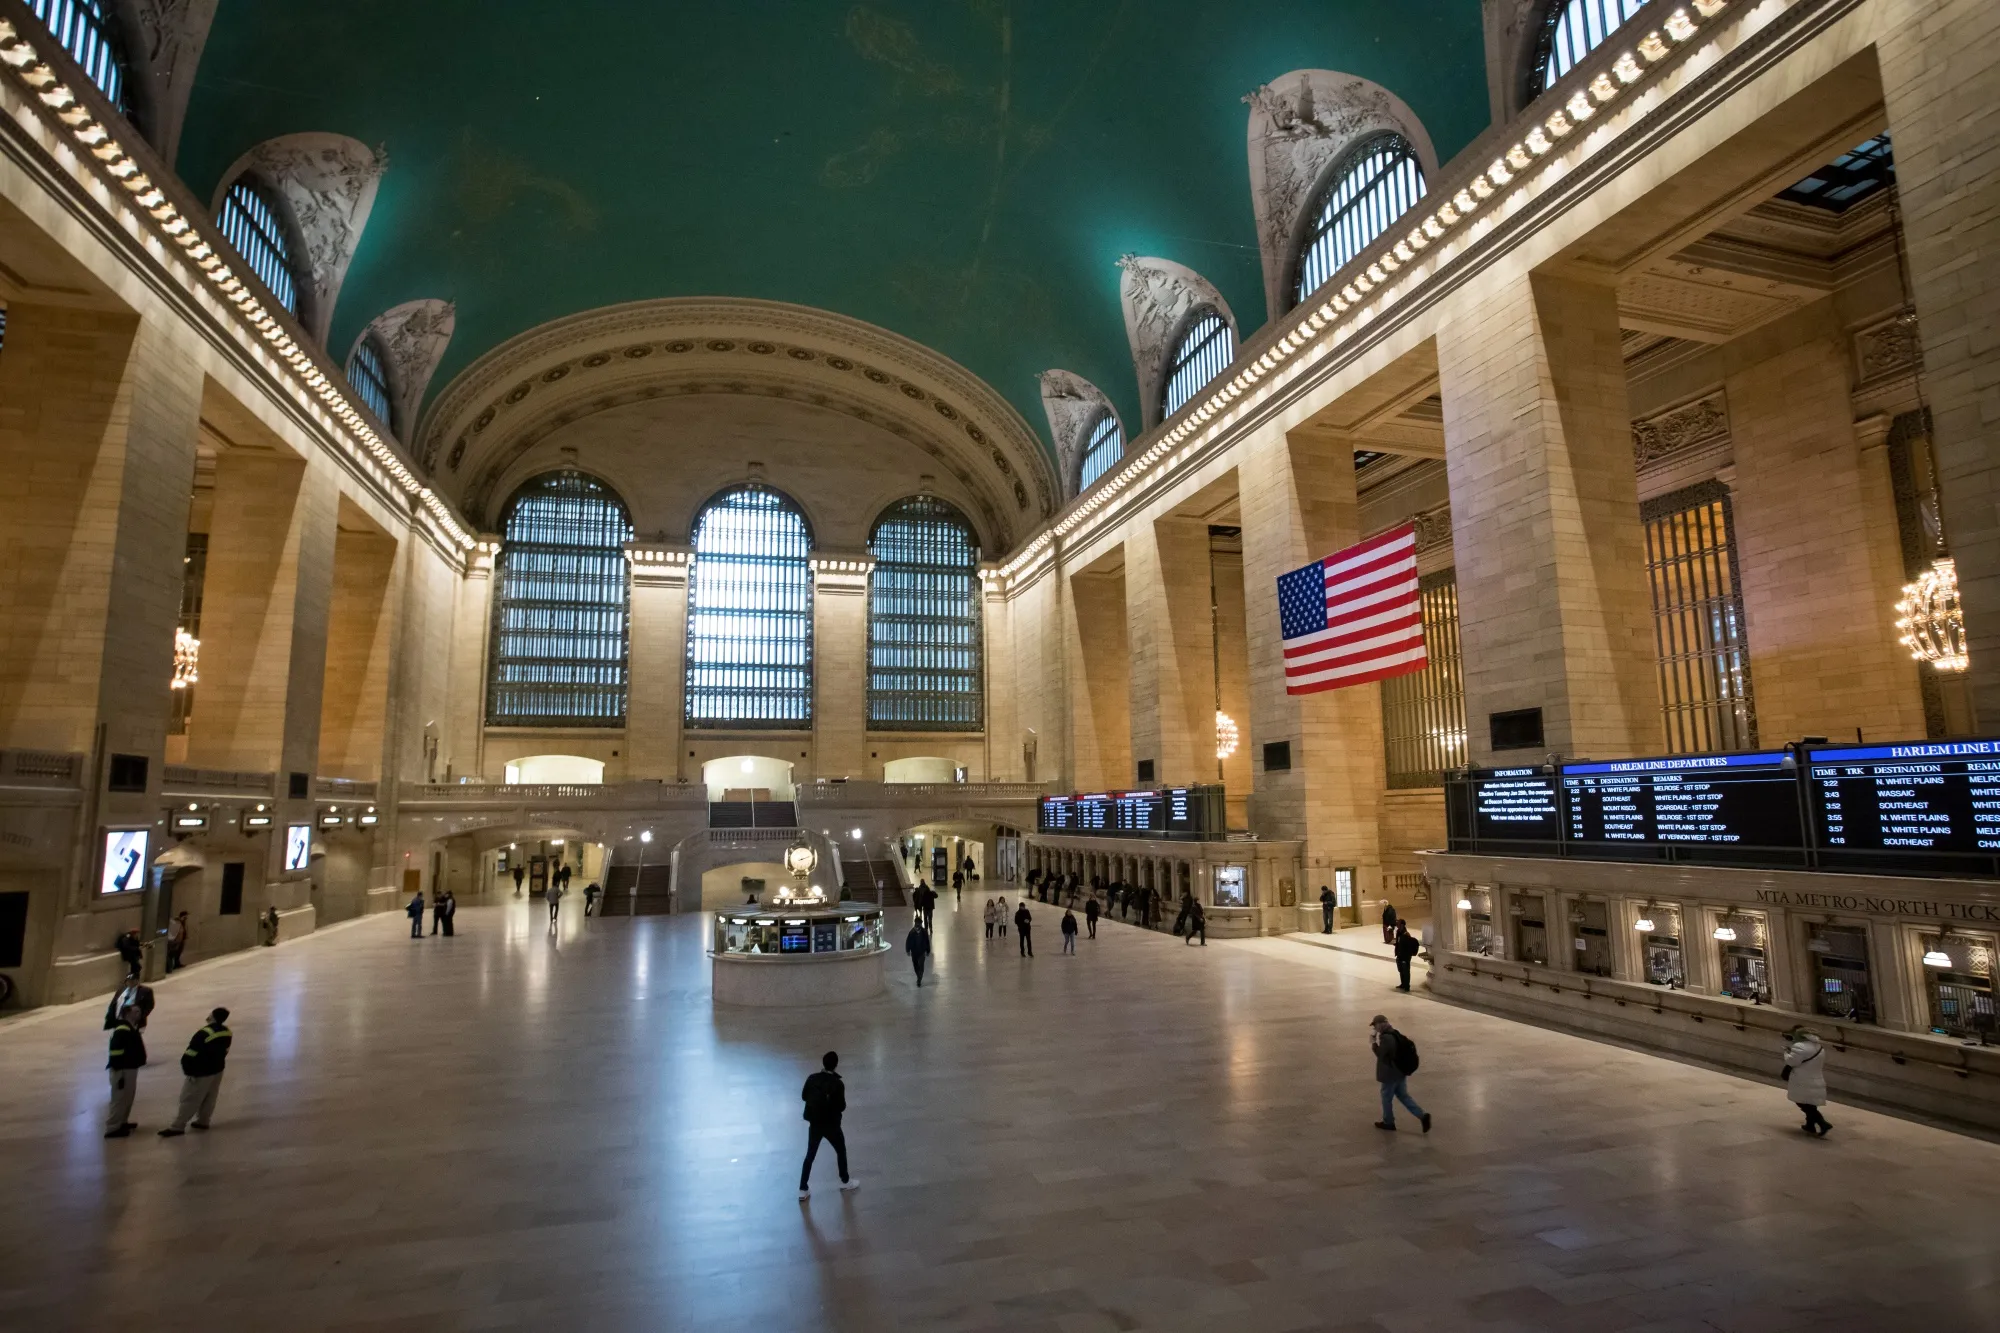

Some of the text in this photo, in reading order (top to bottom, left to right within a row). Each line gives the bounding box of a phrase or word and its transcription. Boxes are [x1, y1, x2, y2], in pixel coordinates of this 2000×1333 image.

[1892, 745, 1950, 757] HARLEM
[1953, 743, 1990, 754] LINE
[1610, 758, 1728, 772] HARLEM LINE DEPARTURES
[1874, 764, 1941, 774] DESTINATION
[1494, 769, 1532, 777] INFORMATION
[1756, 890, 2000, 920] MTA METRO-NORTH TICK
